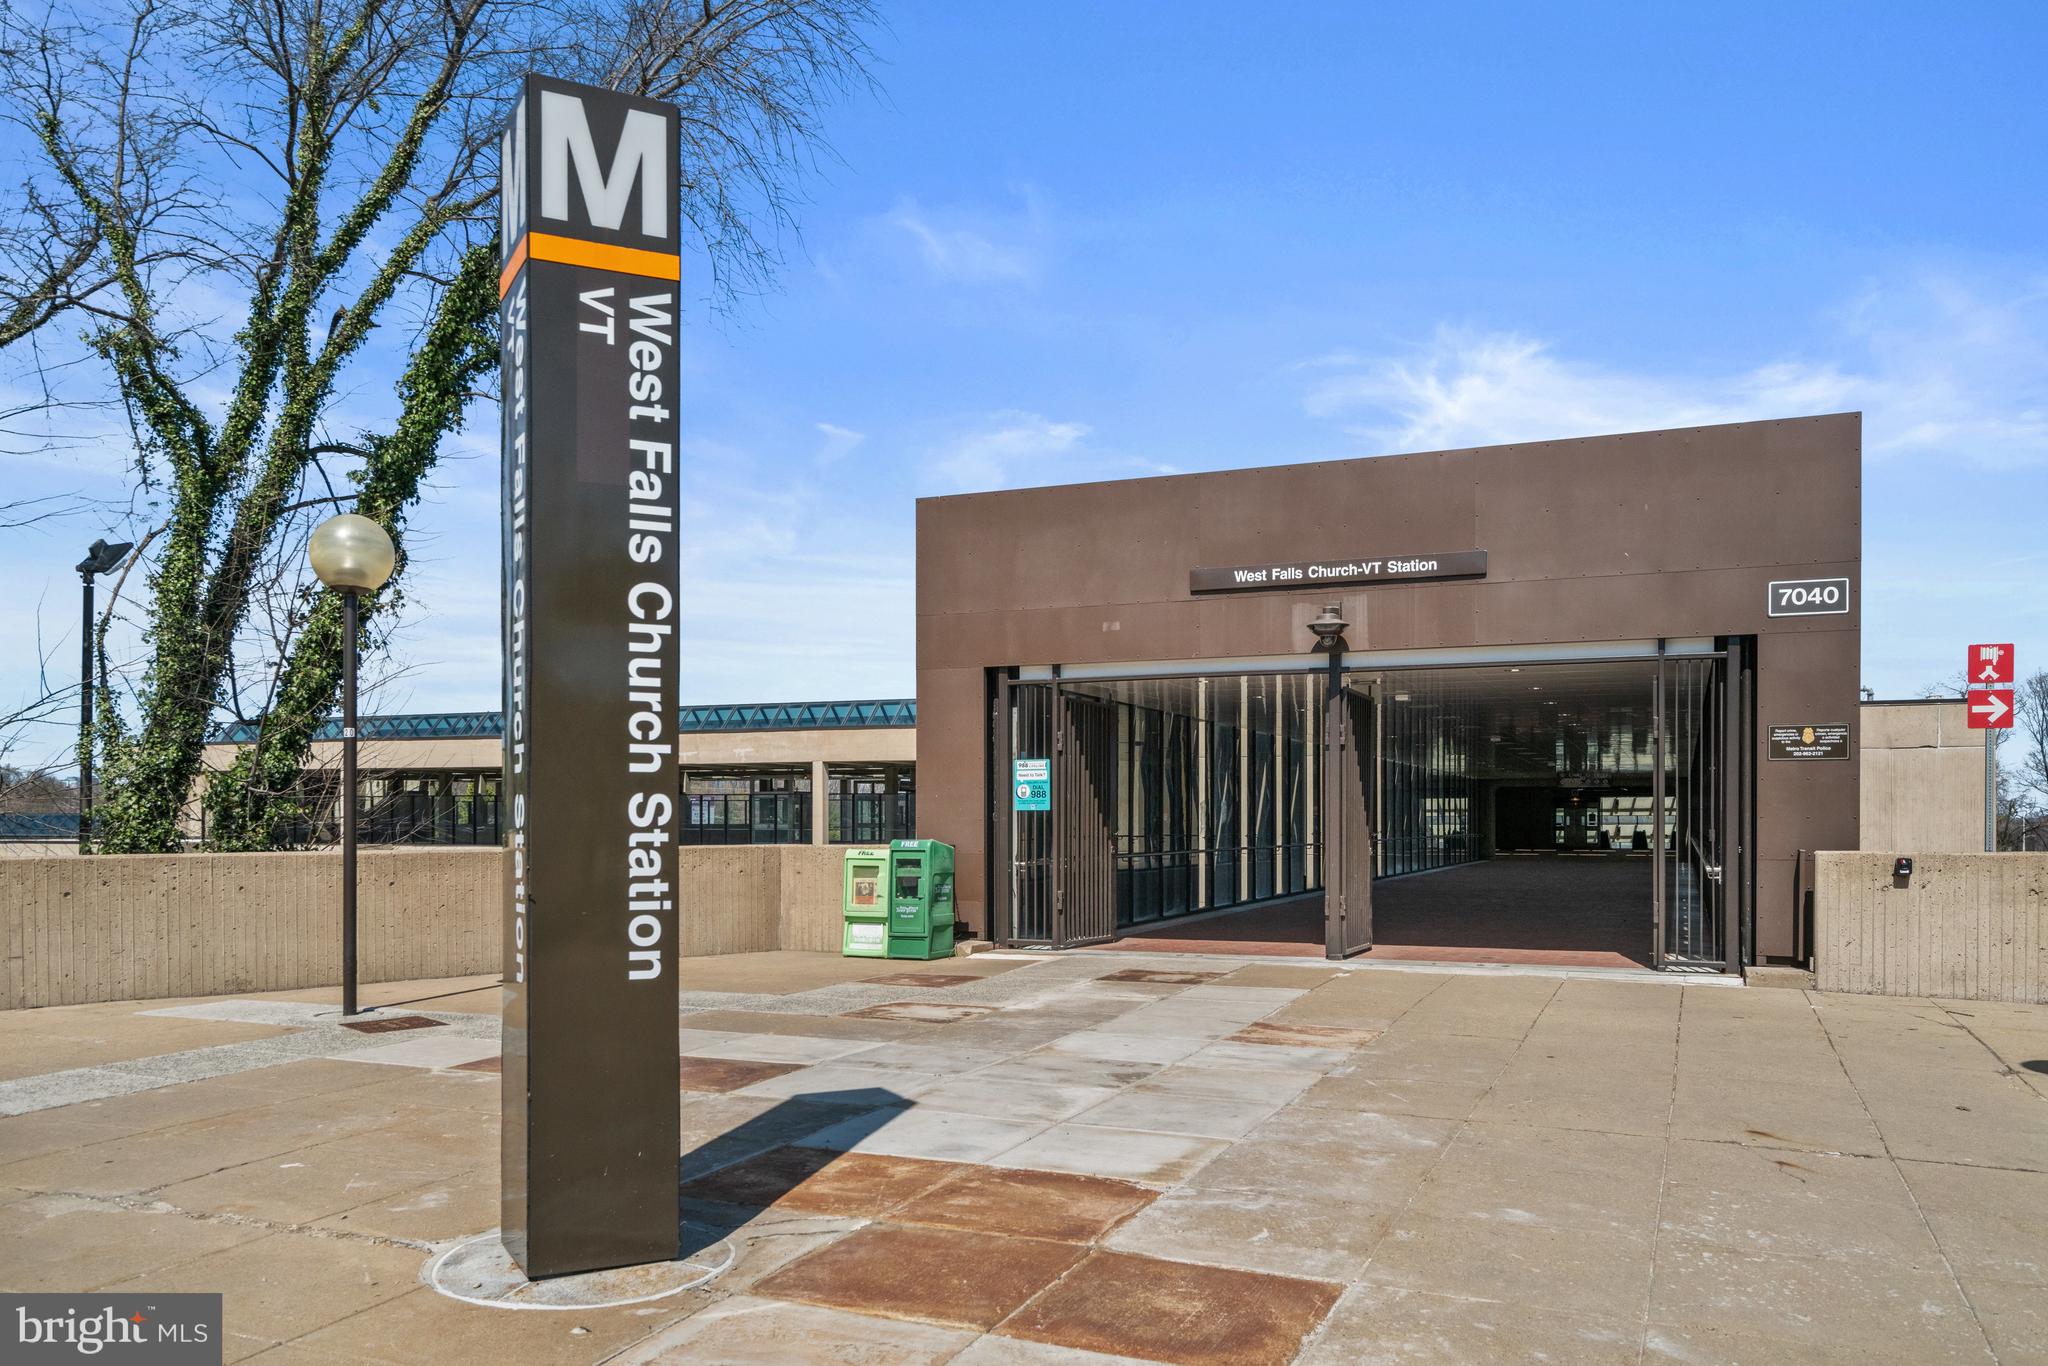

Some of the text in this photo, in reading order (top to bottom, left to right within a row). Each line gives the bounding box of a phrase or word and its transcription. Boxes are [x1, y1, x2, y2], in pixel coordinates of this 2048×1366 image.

[502, 95, 526, 260] M
[541, 90, 668, 239] M
[579, 287, 615, 345] VT
[512, 430, 526, 562] Falls
[627, 293, 673, 981] West Falls Church Station
[1233, 558, 1438, 583] West Falls Church-VT Station
[1778, 586, 1840, 606] 7040
[512, 578, 526, 775] Church
[513, 793, 526, 984] Station
[900, 840, 919, 848] FREE
